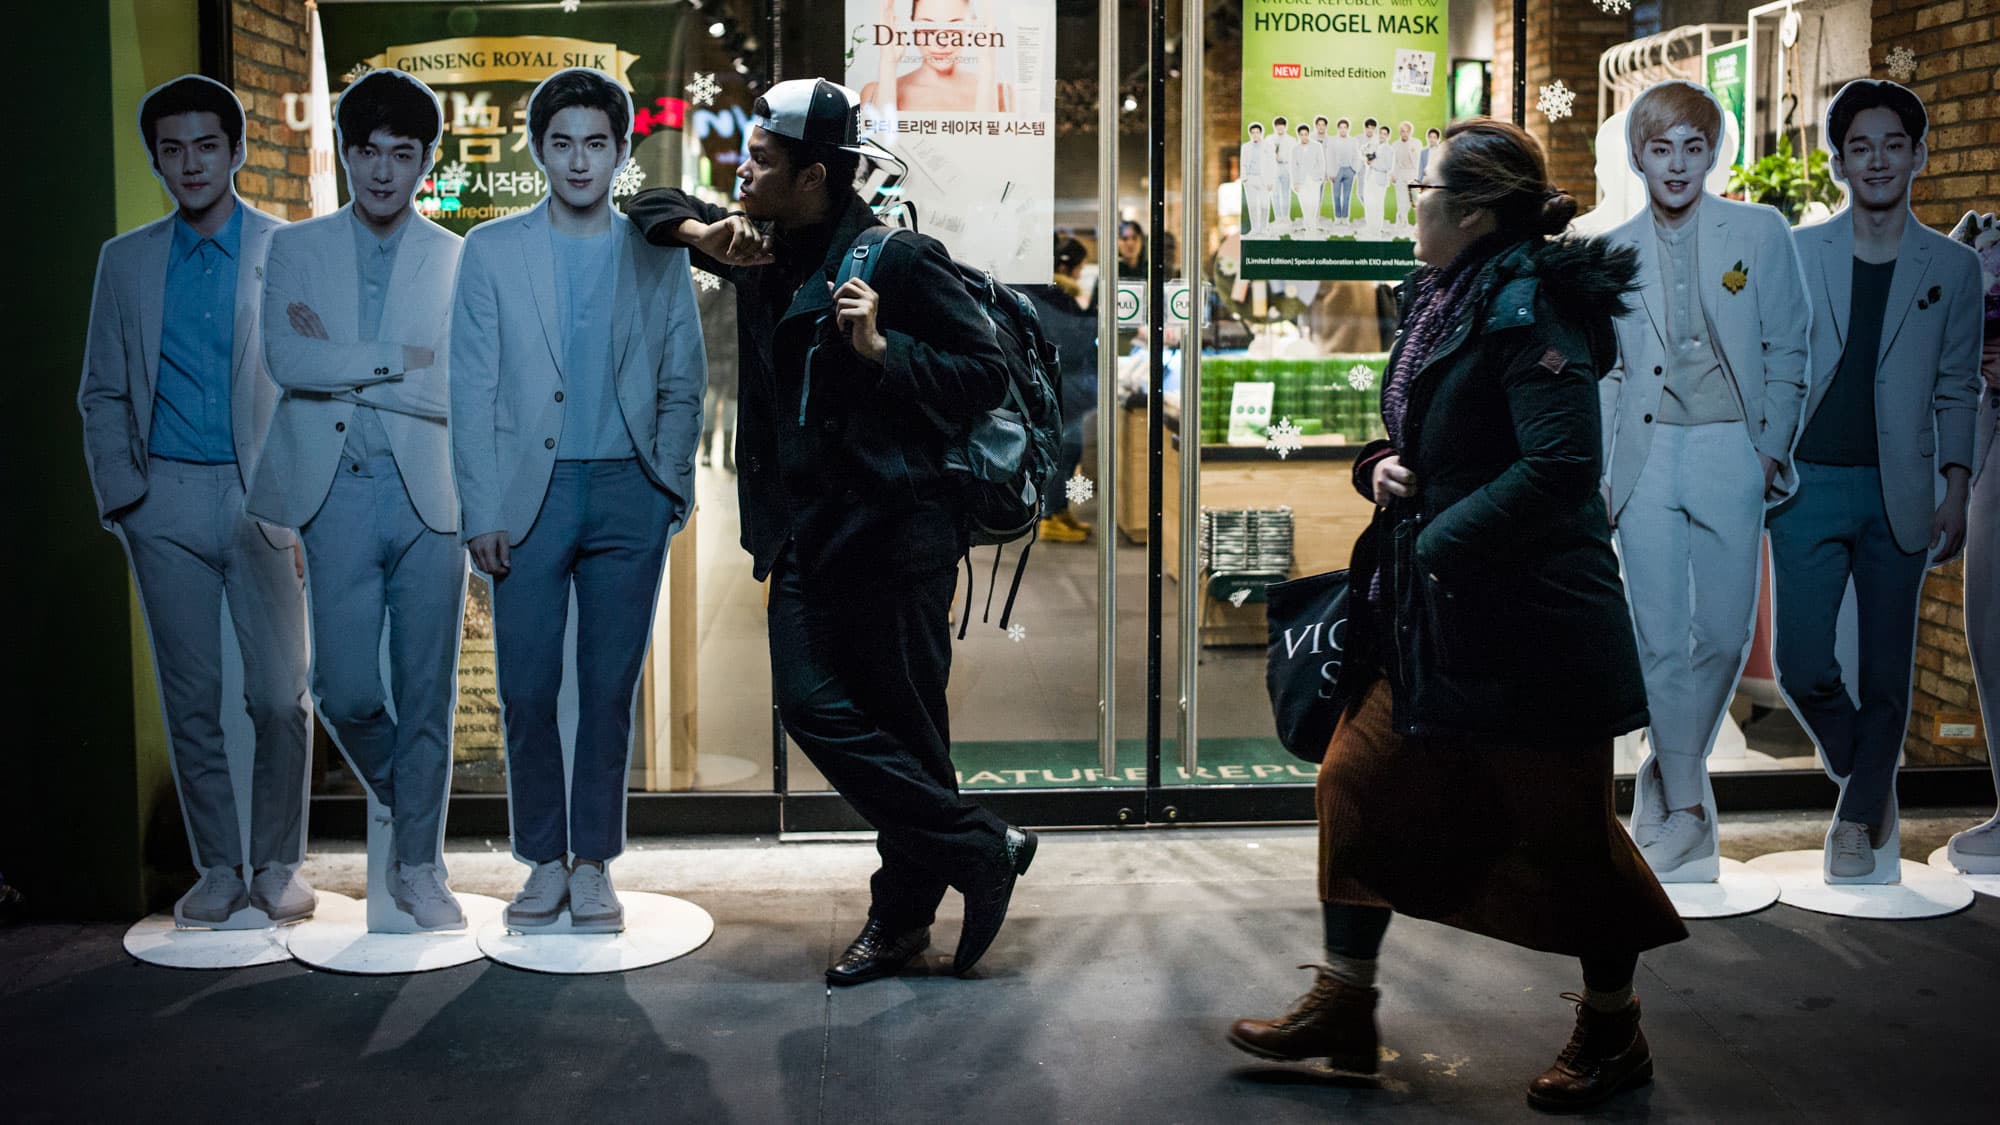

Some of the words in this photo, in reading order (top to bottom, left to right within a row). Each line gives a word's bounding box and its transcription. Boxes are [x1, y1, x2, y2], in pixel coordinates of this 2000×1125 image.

[1254, 12, 1371, 33] HYDROGEL
[1377, 15, 1439, 34] MASK
[872, 24, 1005, 48] Dr.trea:en
[396, 51, 485, 72] GINSENG
[492, 51, 558, 67] ROYAL
[562, 52, 607, 70] SILK
[1274, 66, 1299, 77] NEW
[1303, 67, 1345, 78] Limited
[1348, 67, 1386, 79] Edition
[941, 119, 982, 136] 레이저
[987, 120, 1000, 135] 필
[1004, 120, 1046, 136] 시스템
[470, 170, 548, 197] 시작하
[1294, 257, 1315, 267] Special
[1315, 258, 1355, 266] collaboration
[1355, 258, 1368, 266] with
[1368, 258, 1381, 266] EXO
[1394, 259, 1414, 267] Nature
[1284, 618, 1348, 660] VIC
[1318, 660, 1342, 699] S
[1176, 764, 1321, 780] REPU
